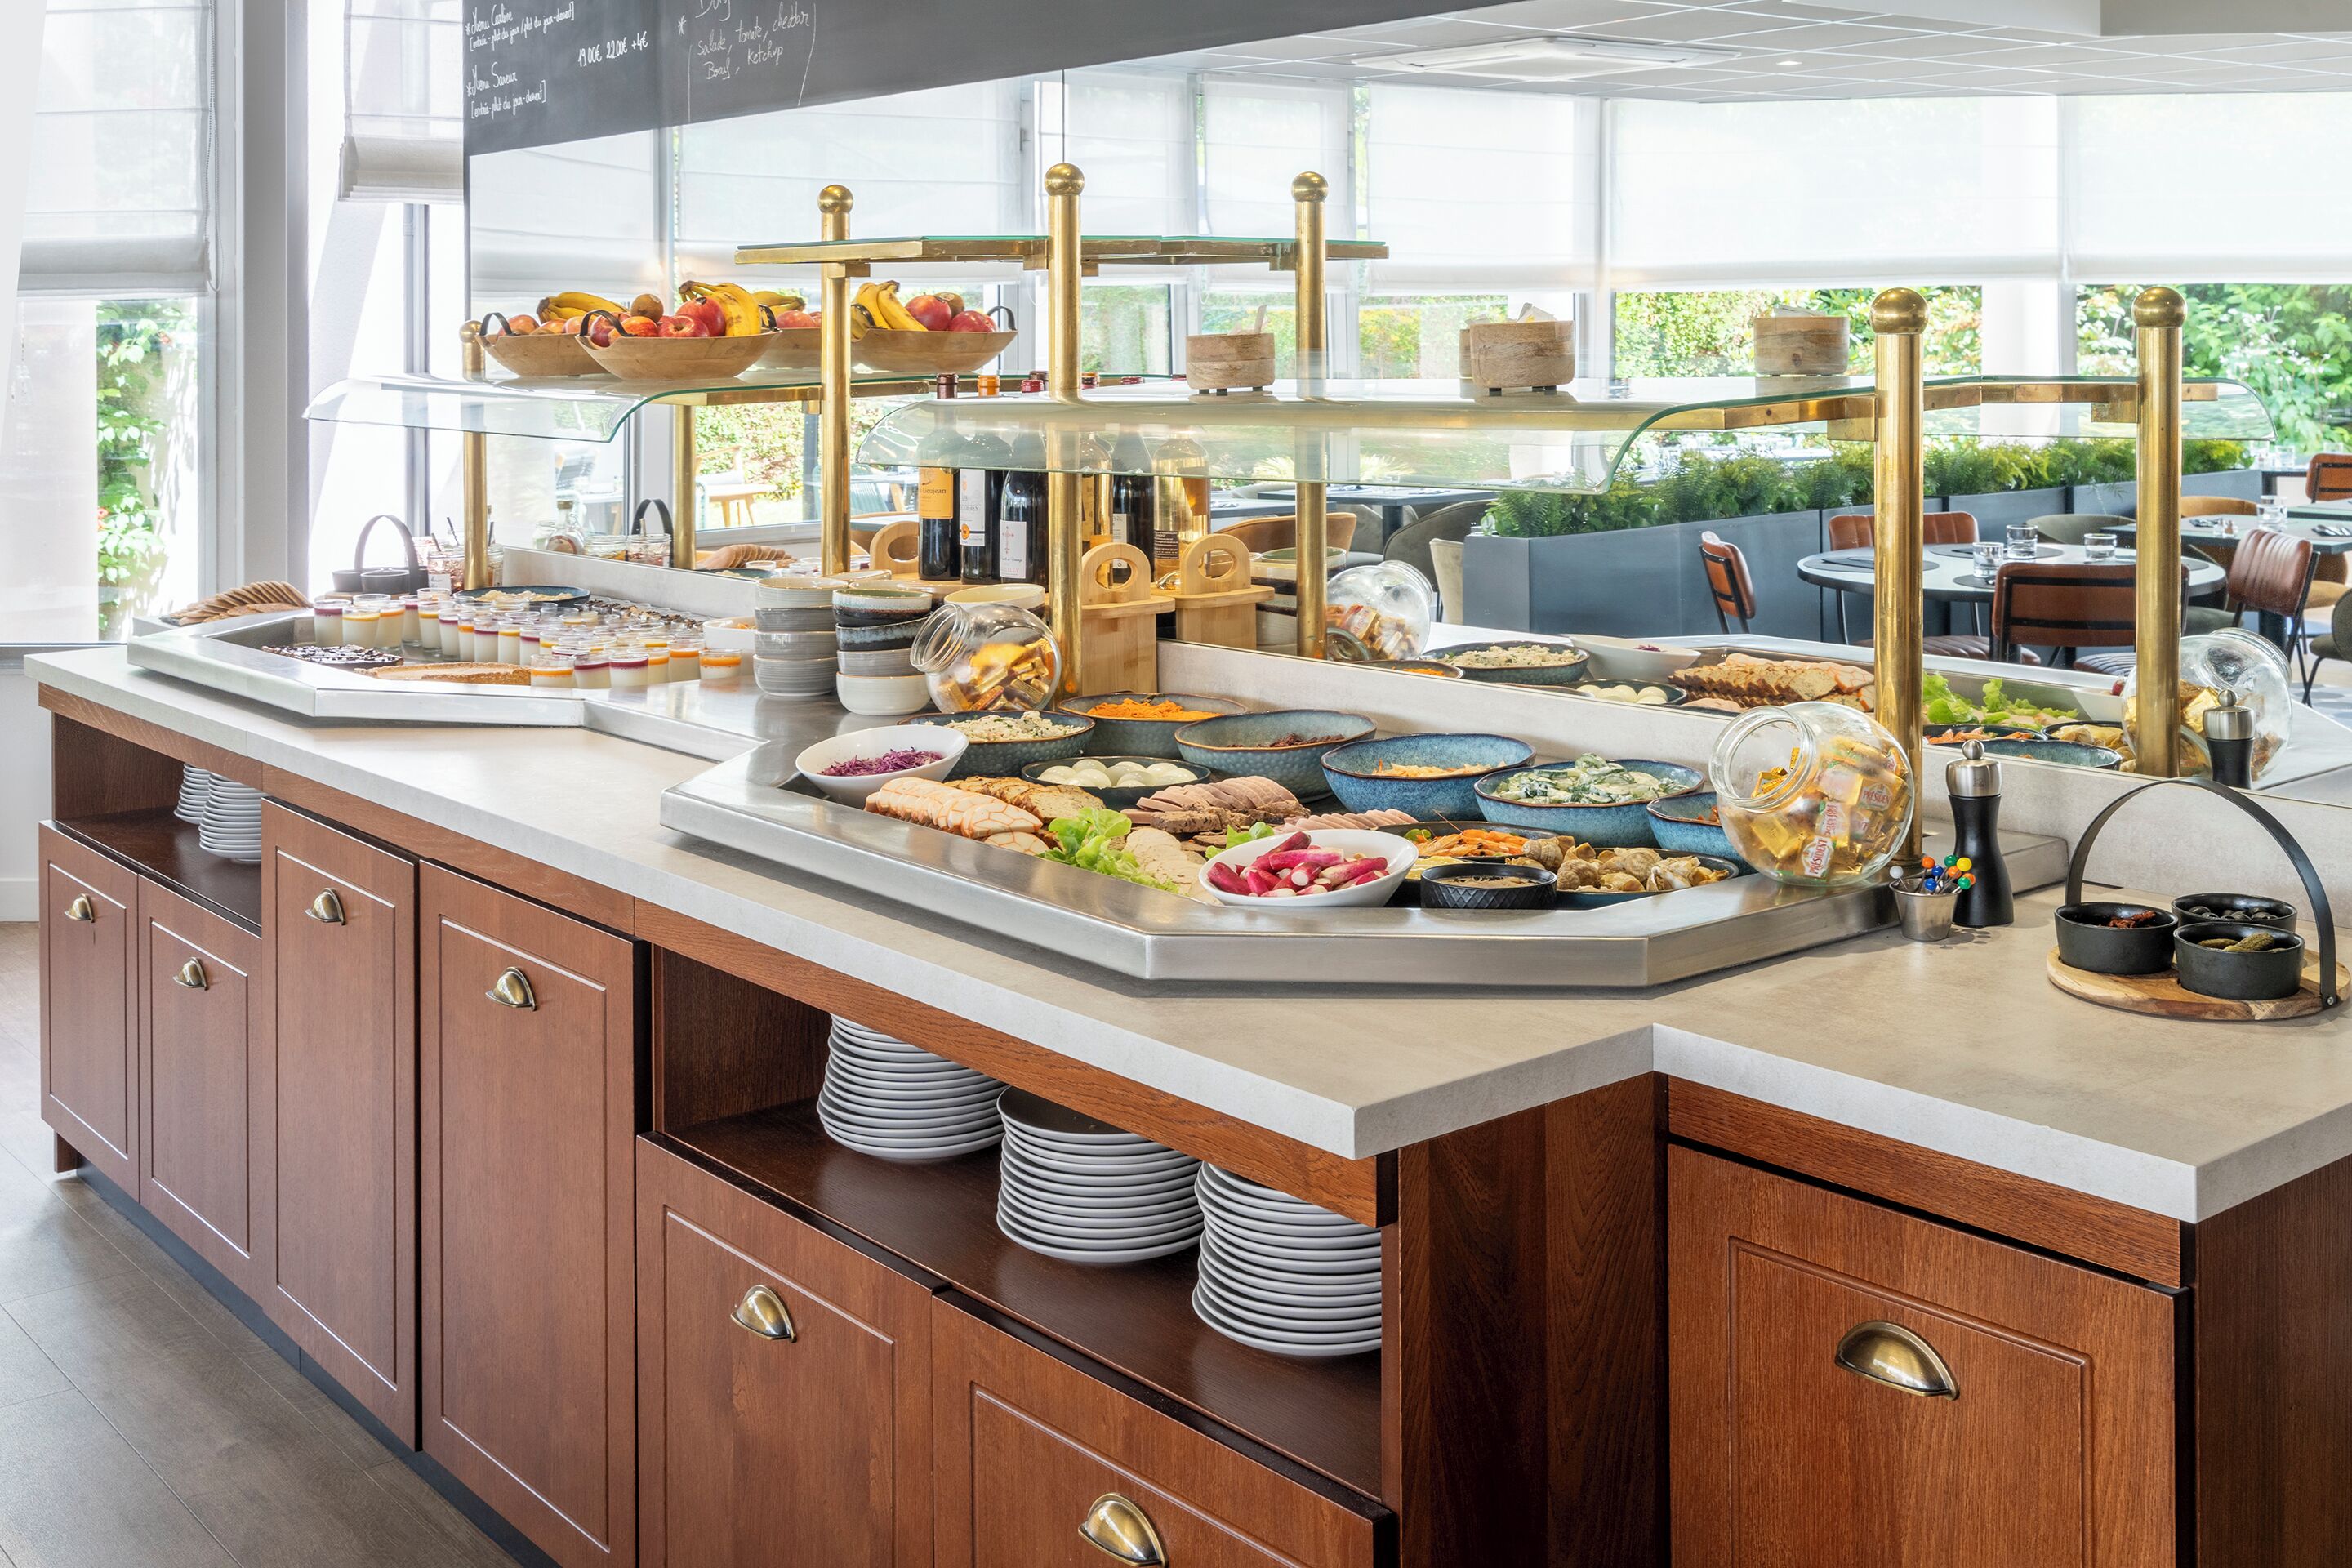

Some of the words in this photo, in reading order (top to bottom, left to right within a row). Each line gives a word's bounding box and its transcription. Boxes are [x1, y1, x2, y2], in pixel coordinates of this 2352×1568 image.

[773, 1, 810, 32] cheddar
[1863, 789, 1891, 804] PRÉSIDEN
[1809, 839, 1829, 875] PRÉSIDENT
